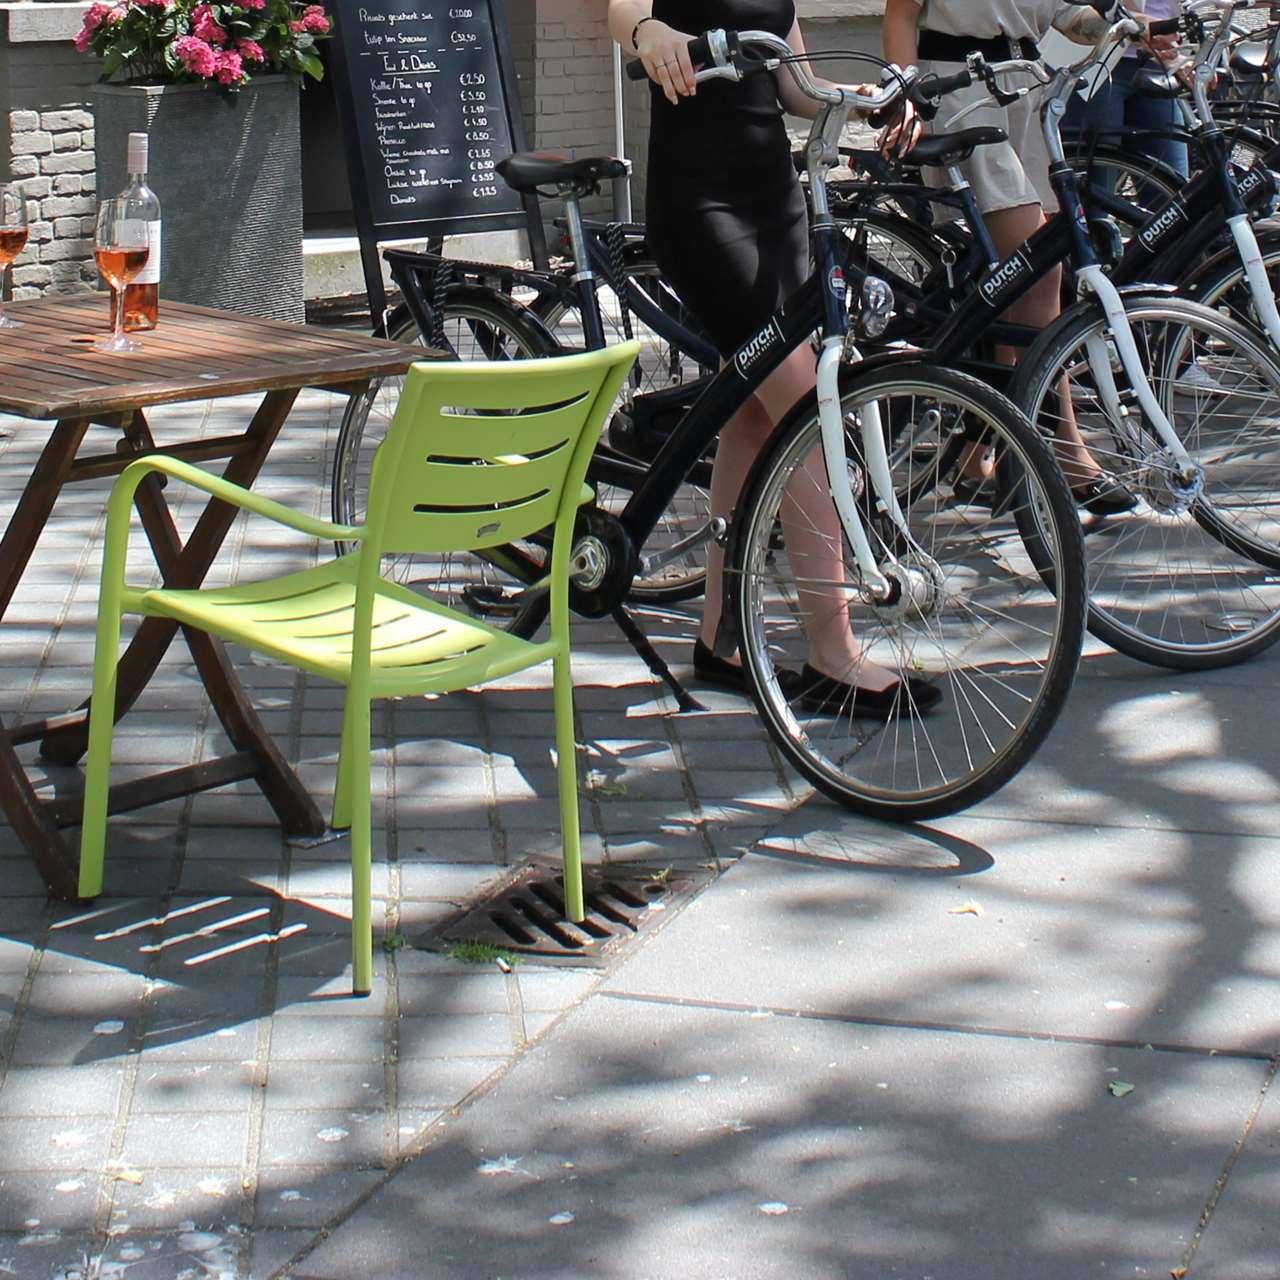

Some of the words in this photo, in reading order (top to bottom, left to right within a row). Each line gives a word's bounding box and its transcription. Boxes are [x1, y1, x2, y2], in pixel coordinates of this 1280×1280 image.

[1238, 172, 1259, 195] TCH
[1143, 208, 1178, 242] DUTCH
[984, 256, 1022, 295] DUTCH
[739, 323, 775, 365] DUTCH
